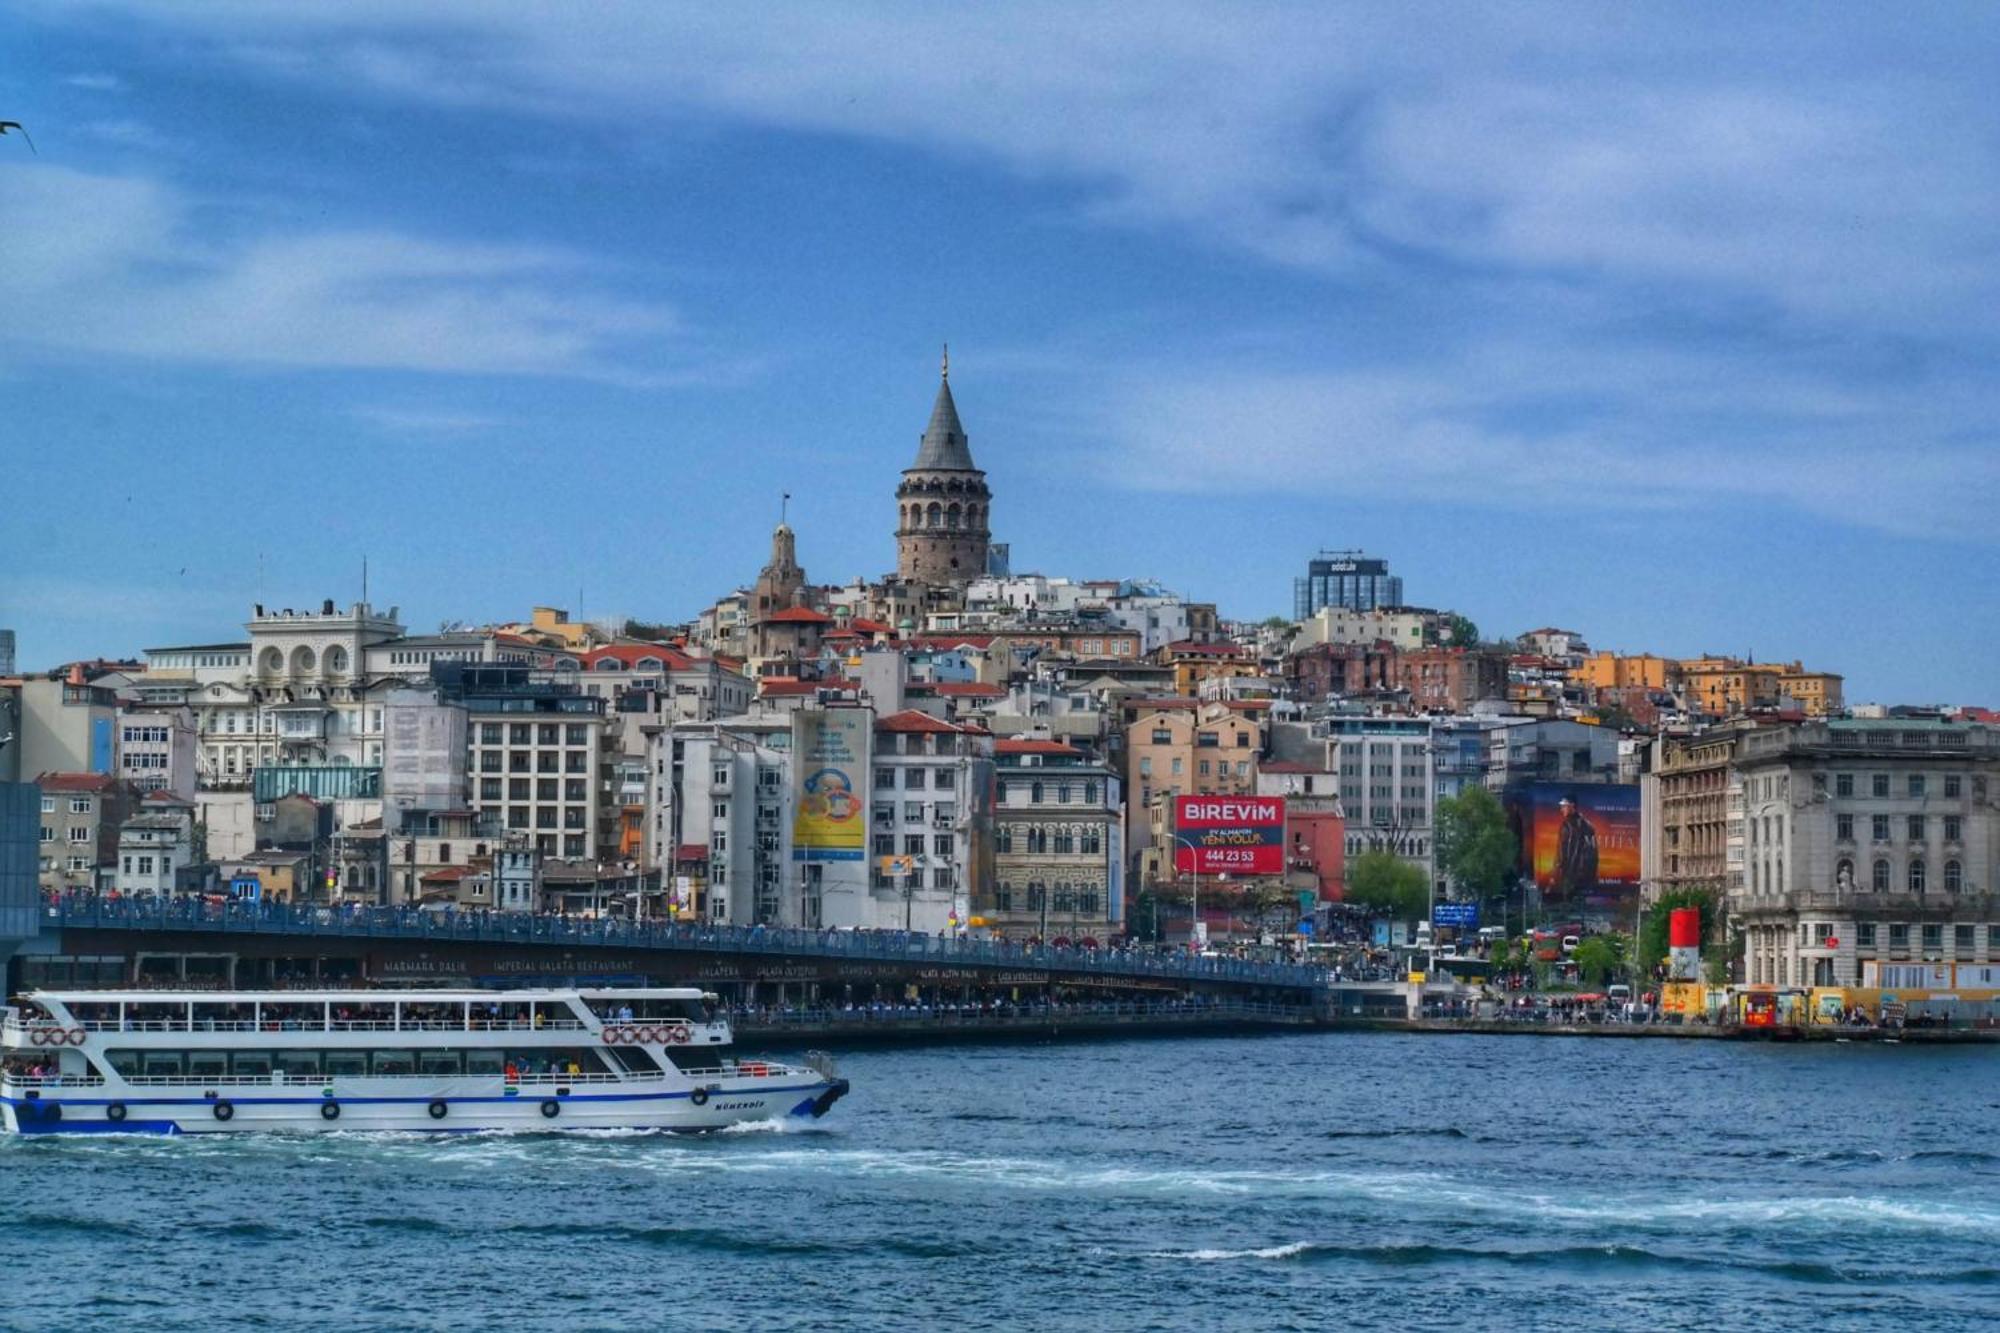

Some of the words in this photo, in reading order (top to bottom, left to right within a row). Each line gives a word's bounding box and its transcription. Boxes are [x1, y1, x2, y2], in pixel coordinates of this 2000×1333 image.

[1206, 851, 1224, 861] 444
[1226, 851, 1239, 861] 23
[1241, 851, 1255, 861] 53
[384, 961, 435, 972] MARMARA
